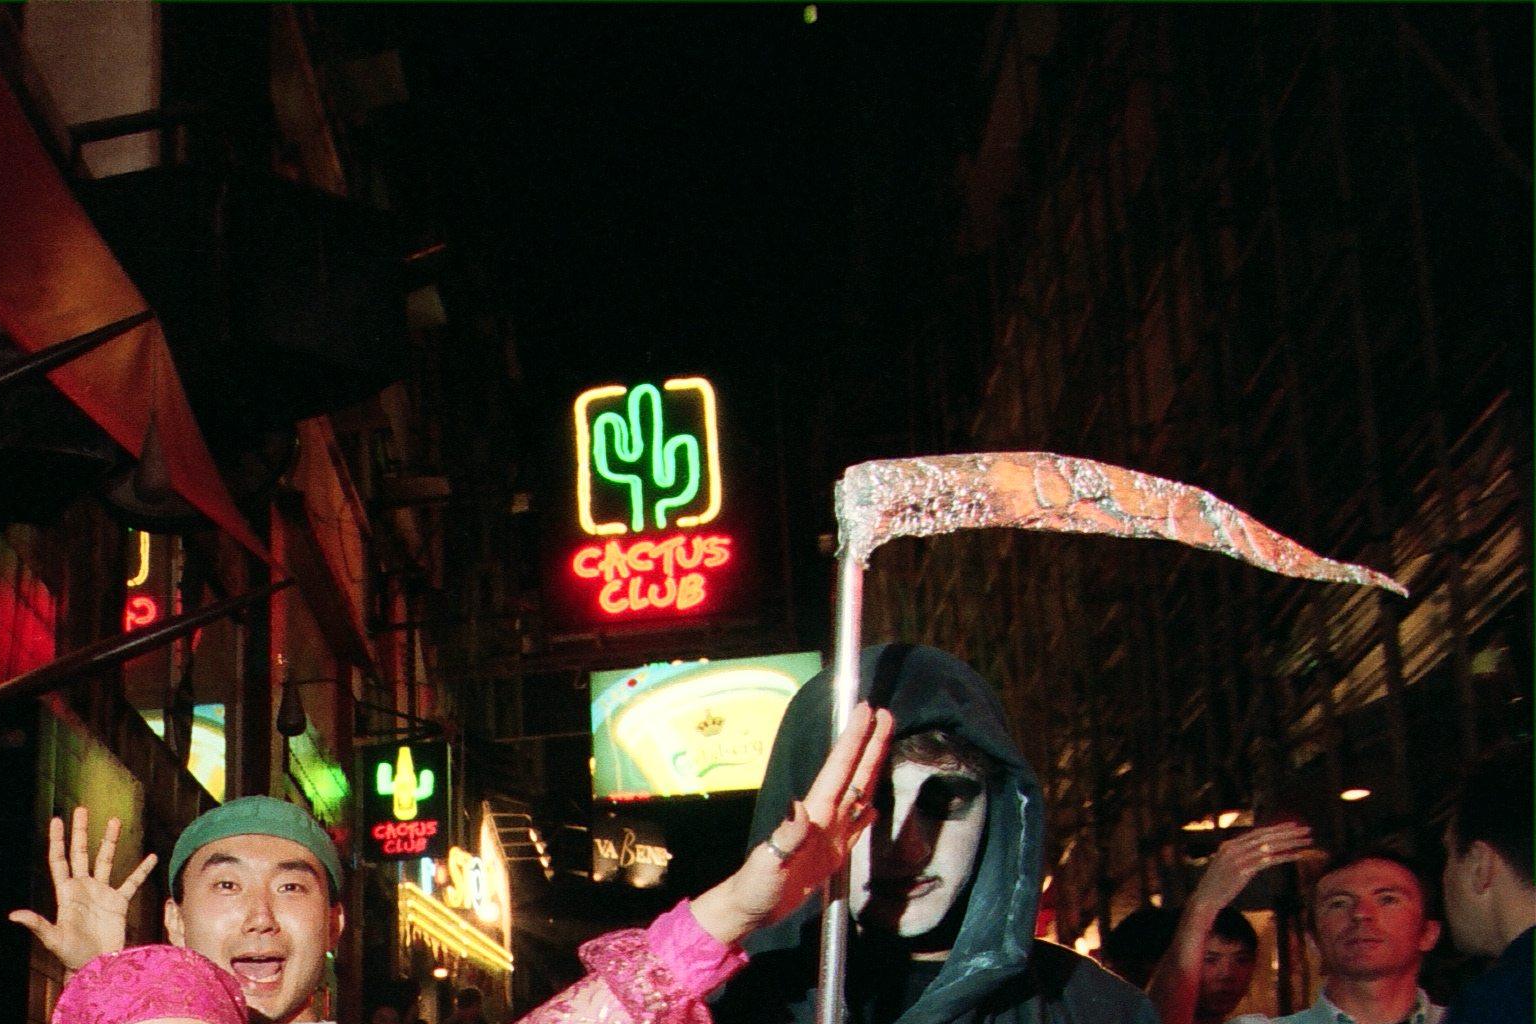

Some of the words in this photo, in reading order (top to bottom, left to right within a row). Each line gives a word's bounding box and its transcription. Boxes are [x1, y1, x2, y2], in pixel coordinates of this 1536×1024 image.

[572, 536, 733, 581] CACTUS
[598, 573, 706, 614] CLUB
[372, 819, 438, 840] CACTUS
[383, 837, 427, 854] CLUB
